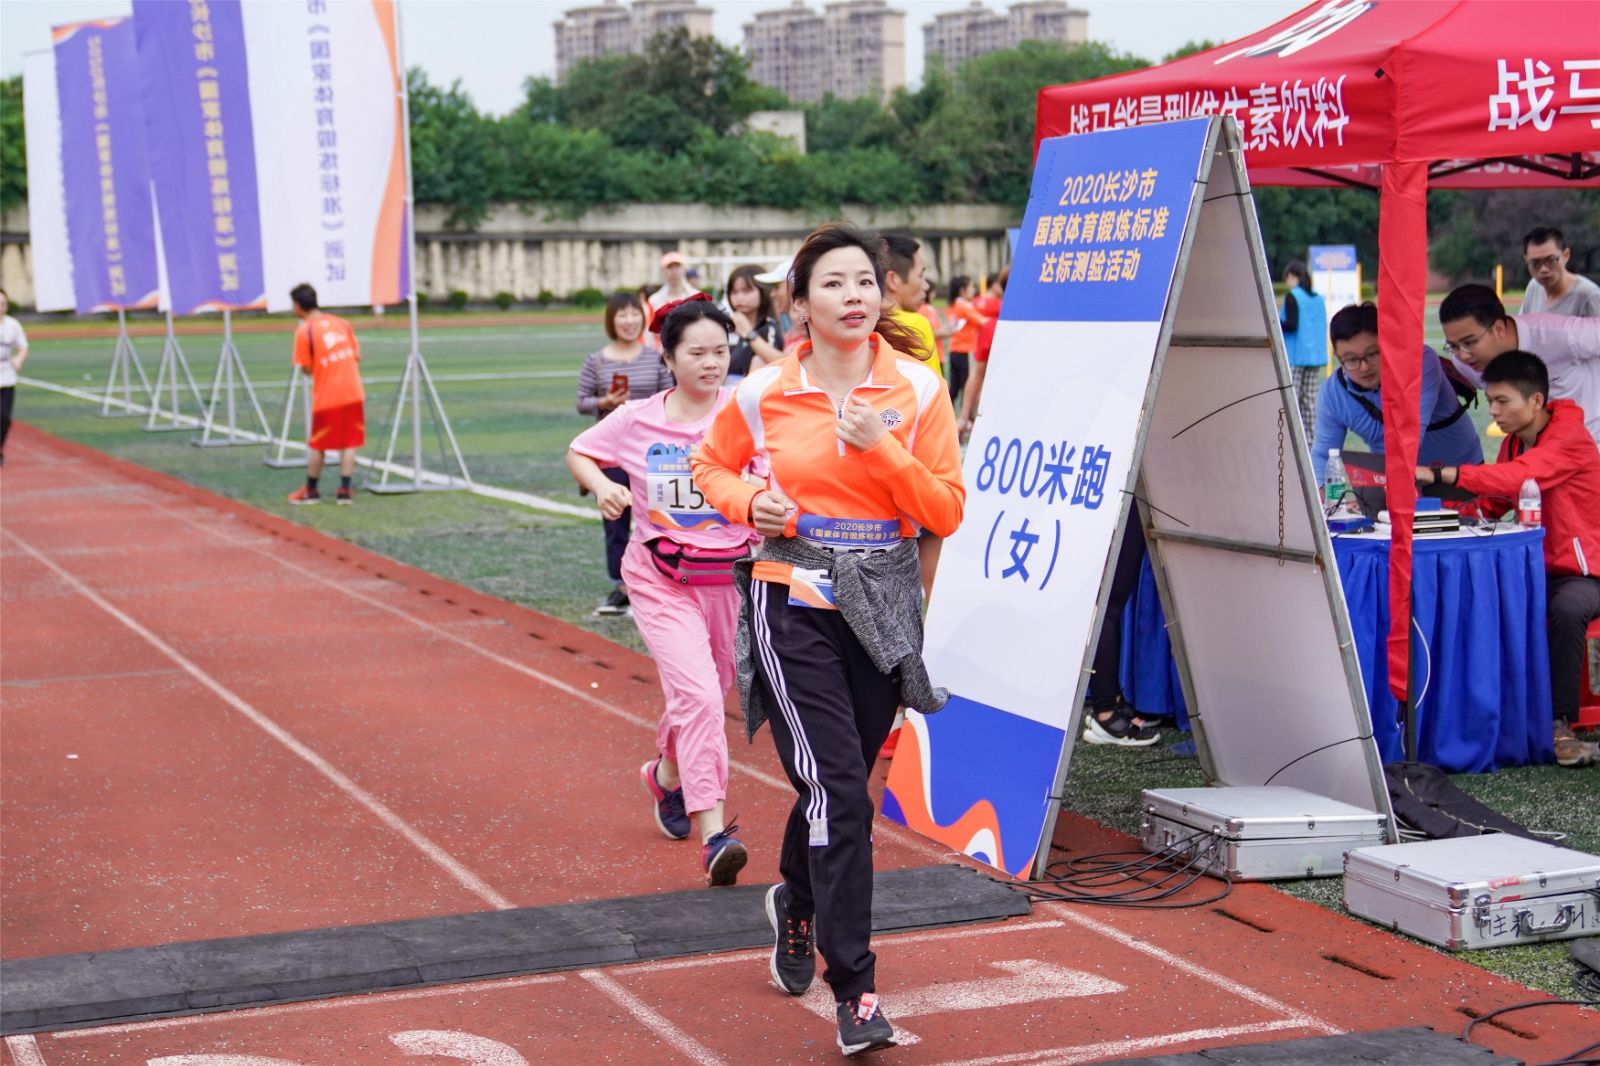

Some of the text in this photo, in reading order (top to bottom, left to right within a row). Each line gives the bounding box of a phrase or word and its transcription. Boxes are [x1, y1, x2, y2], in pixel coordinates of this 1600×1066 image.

[1487, 57, 1600, 132] 战马
[1058, 167, 1158, 206] 2020长沙市
[1033, 206, 1170, 247] 国家体育锻炼标准
[1038, 247, 1141, 283] 达标测验活动
[976, 435, 1112, 511] 800米跑
[668, 478, 716, 510] 15
[834, 521, 883, 532] 2020长沙市
[984, 510, 1061, 591] （女）
